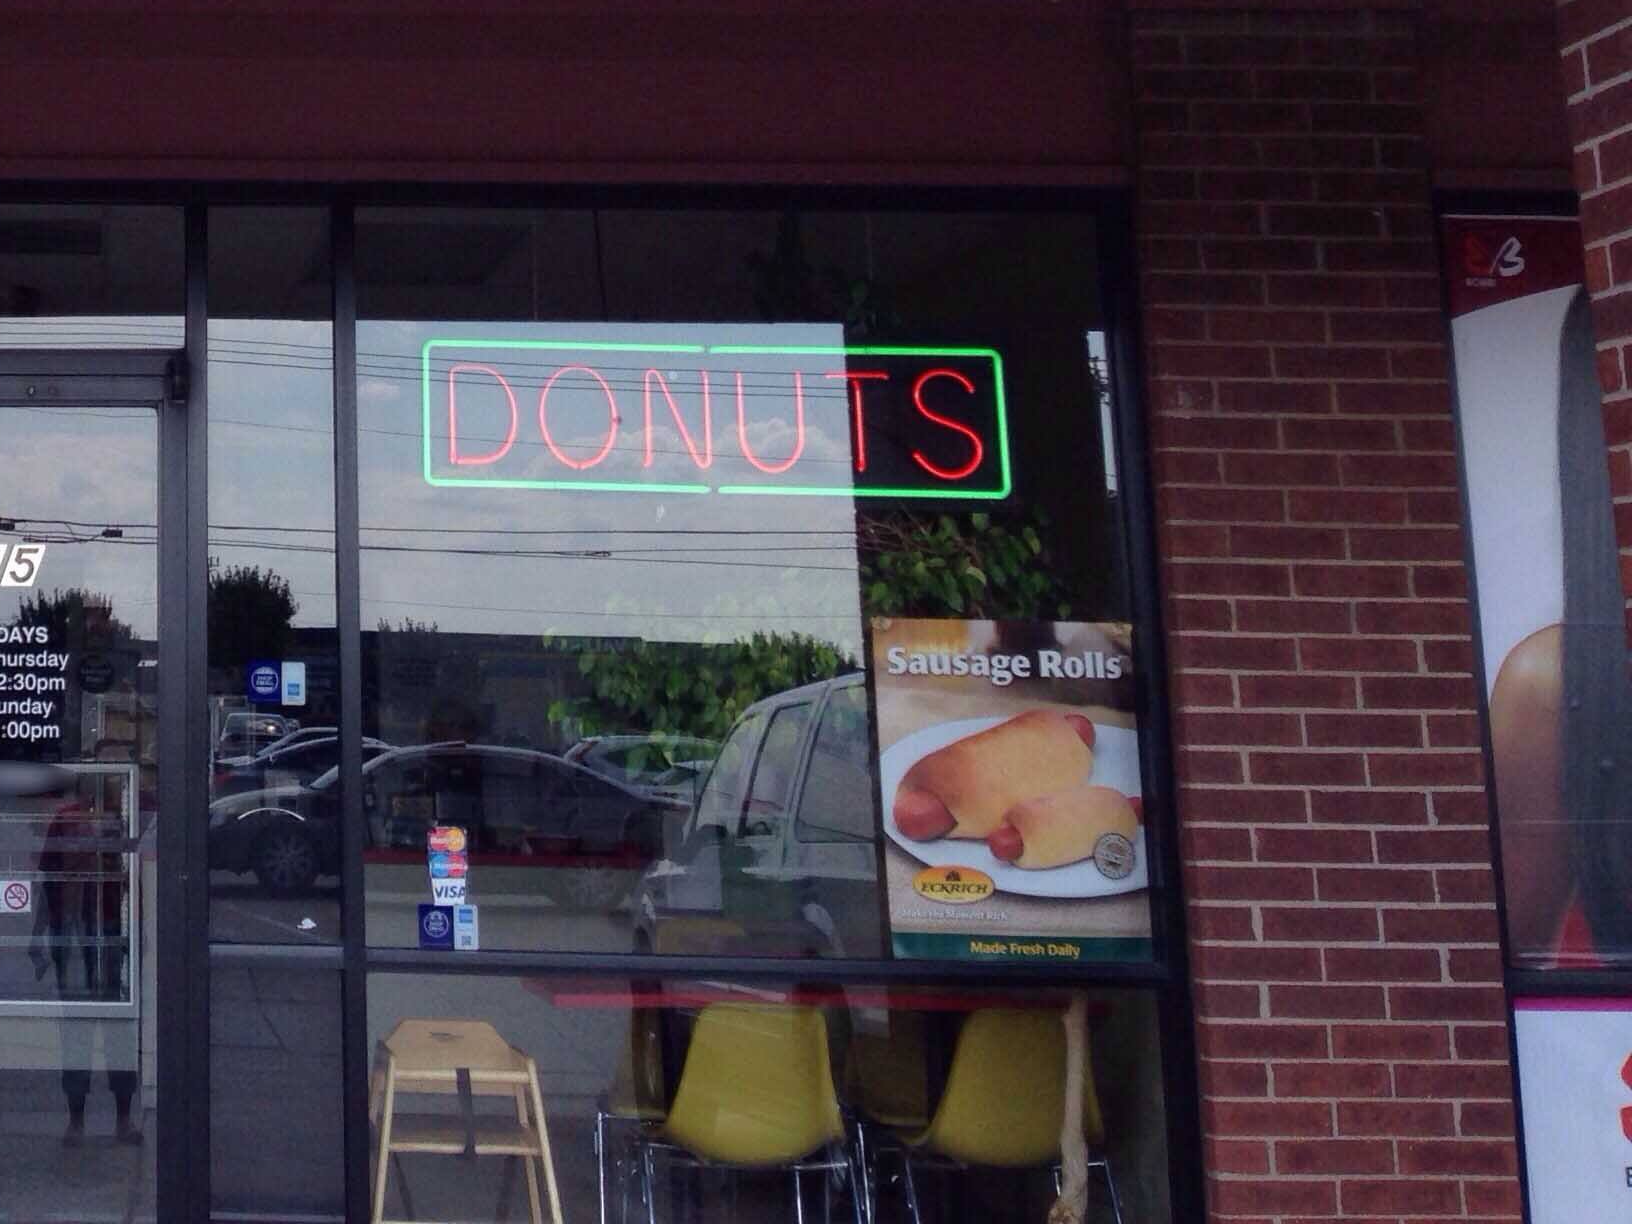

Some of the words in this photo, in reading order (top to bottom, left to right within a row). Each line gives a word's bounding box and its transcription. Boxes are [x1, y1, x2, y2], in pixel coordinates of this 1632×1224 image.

[448, 362, 984, 479] DONUTS
[887, 646, 1031, 685] Sausage
[1037, 650, 1122, 680] Rolls
[434, 885, 466, 899] VISA
[920, 883, 988, 895] ECKRICH
[970, 940, 1008, 955] Made
[1011, 942, 1045, 955] Fresh
[1048, 943, 1081, 960] Daily
